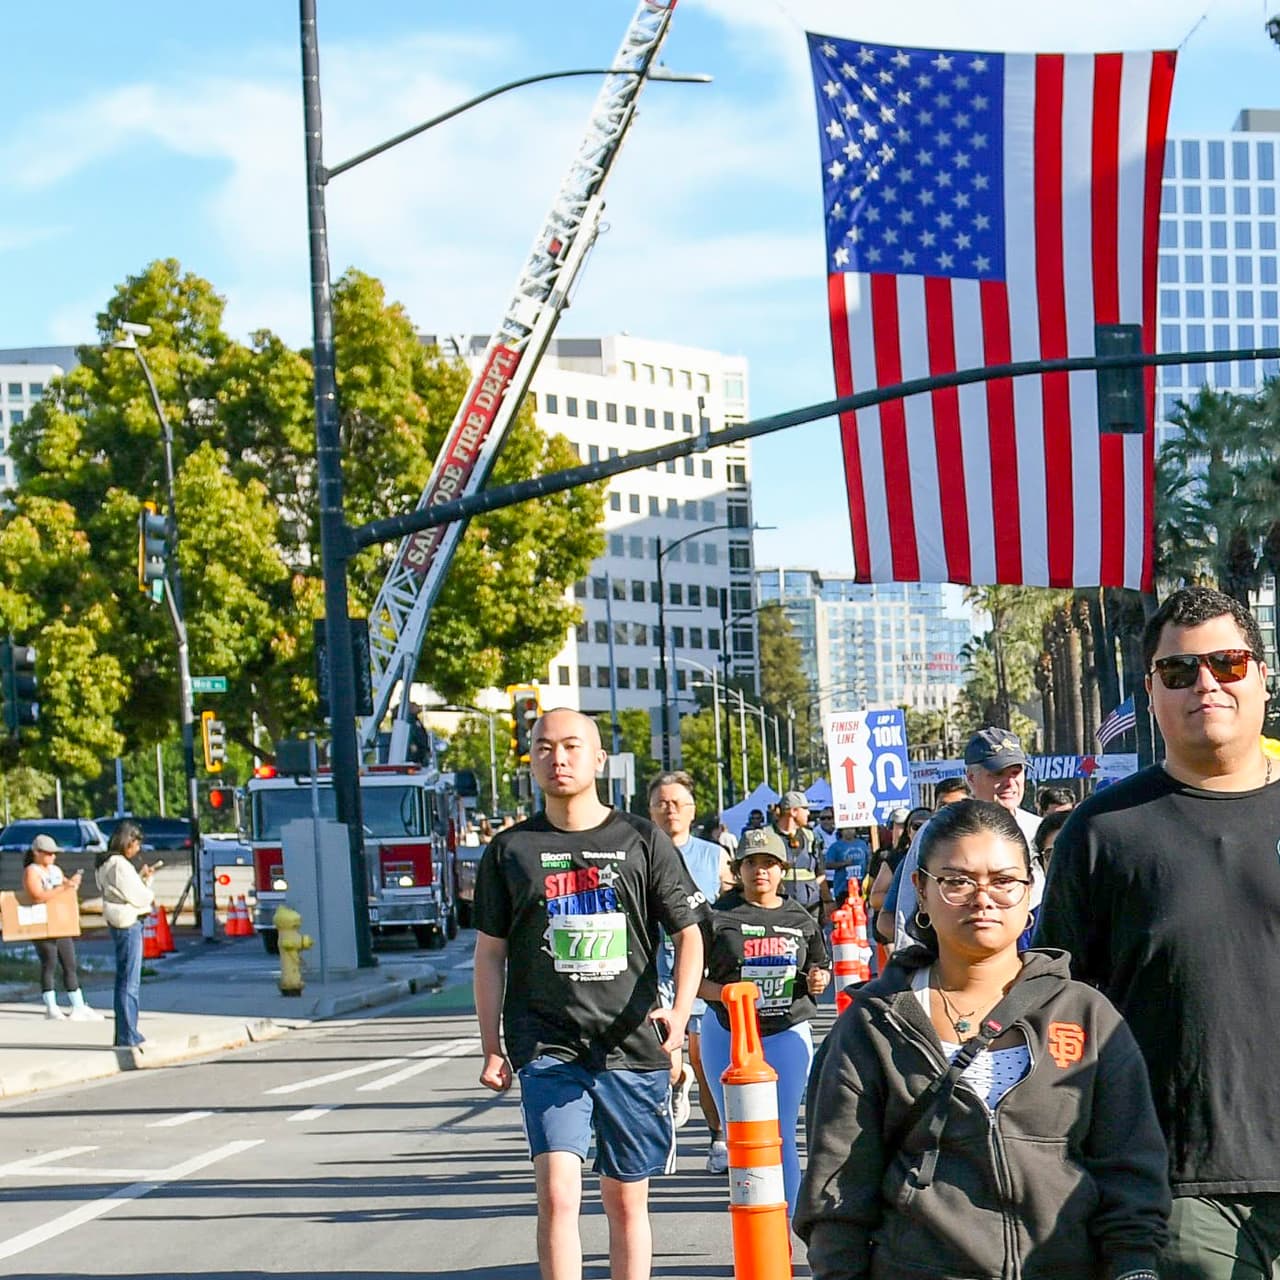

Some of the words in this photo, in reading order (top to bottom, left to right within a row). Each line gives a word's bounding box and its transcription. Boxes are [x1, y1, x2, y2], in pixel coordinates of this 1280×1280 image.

[432, 464, 463, 506] OSE
[453, 411, 485, 463] FIRE
[475, 350, 514, 411] DEPT.
[831, 721, 859, 732] FINISH
[837, 733, 855, 744] LINE
[873, 725, 903, 747] 10K
[1027, 756, 1076, 780] INISH
[544, 866, 599, 899] STARS
[547, 888, 617, 917] STRIDES
[568, 931, 614, 959] 777
[743, 937, 788, 957] STARS
